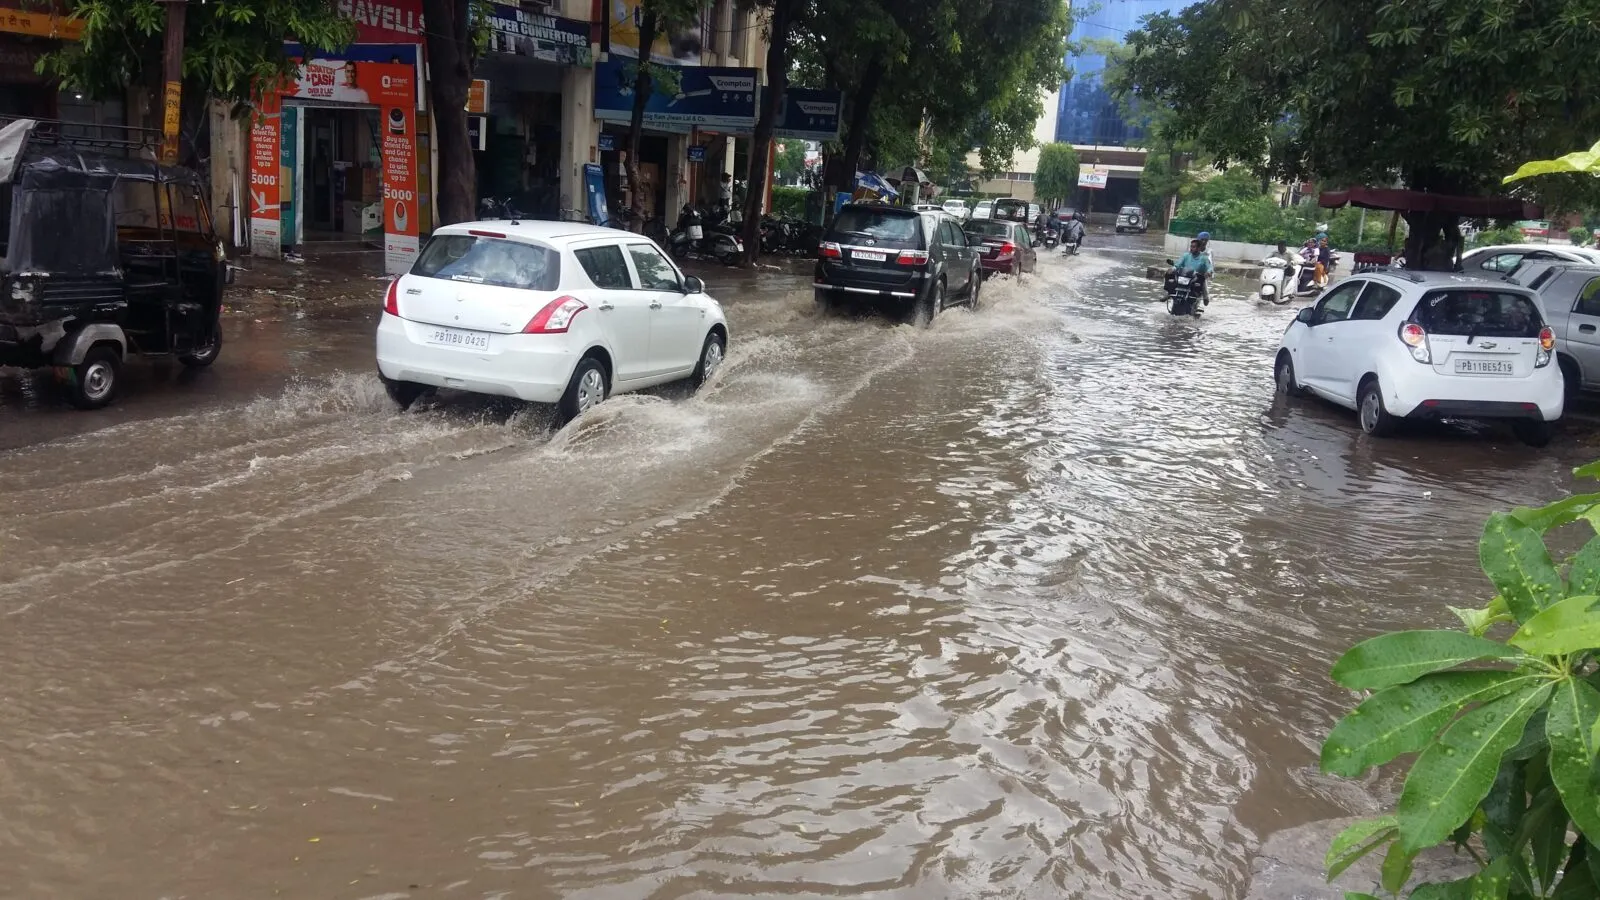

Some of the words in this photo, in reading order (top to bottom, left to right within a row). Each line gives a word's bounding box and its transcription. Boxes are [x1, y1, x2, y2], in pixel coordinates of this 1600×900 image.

[338, 0, 425, 35] HAVELLS
[515, 9, 557, 29] BHARAT
[484, 15, 519, 33] PAPER
[520, 22, 587, 46] CONVERTORS
[306, 63, 336, 75] SCRATCH
[311, 73, 335, 87] CASH
[716, 79, 751, 89] Crompton
[434, 331, 463, 344] PB11BU
[465, 335, 486, 347] 0426
[1461, 360, 1513, 372] PB11BE5219
